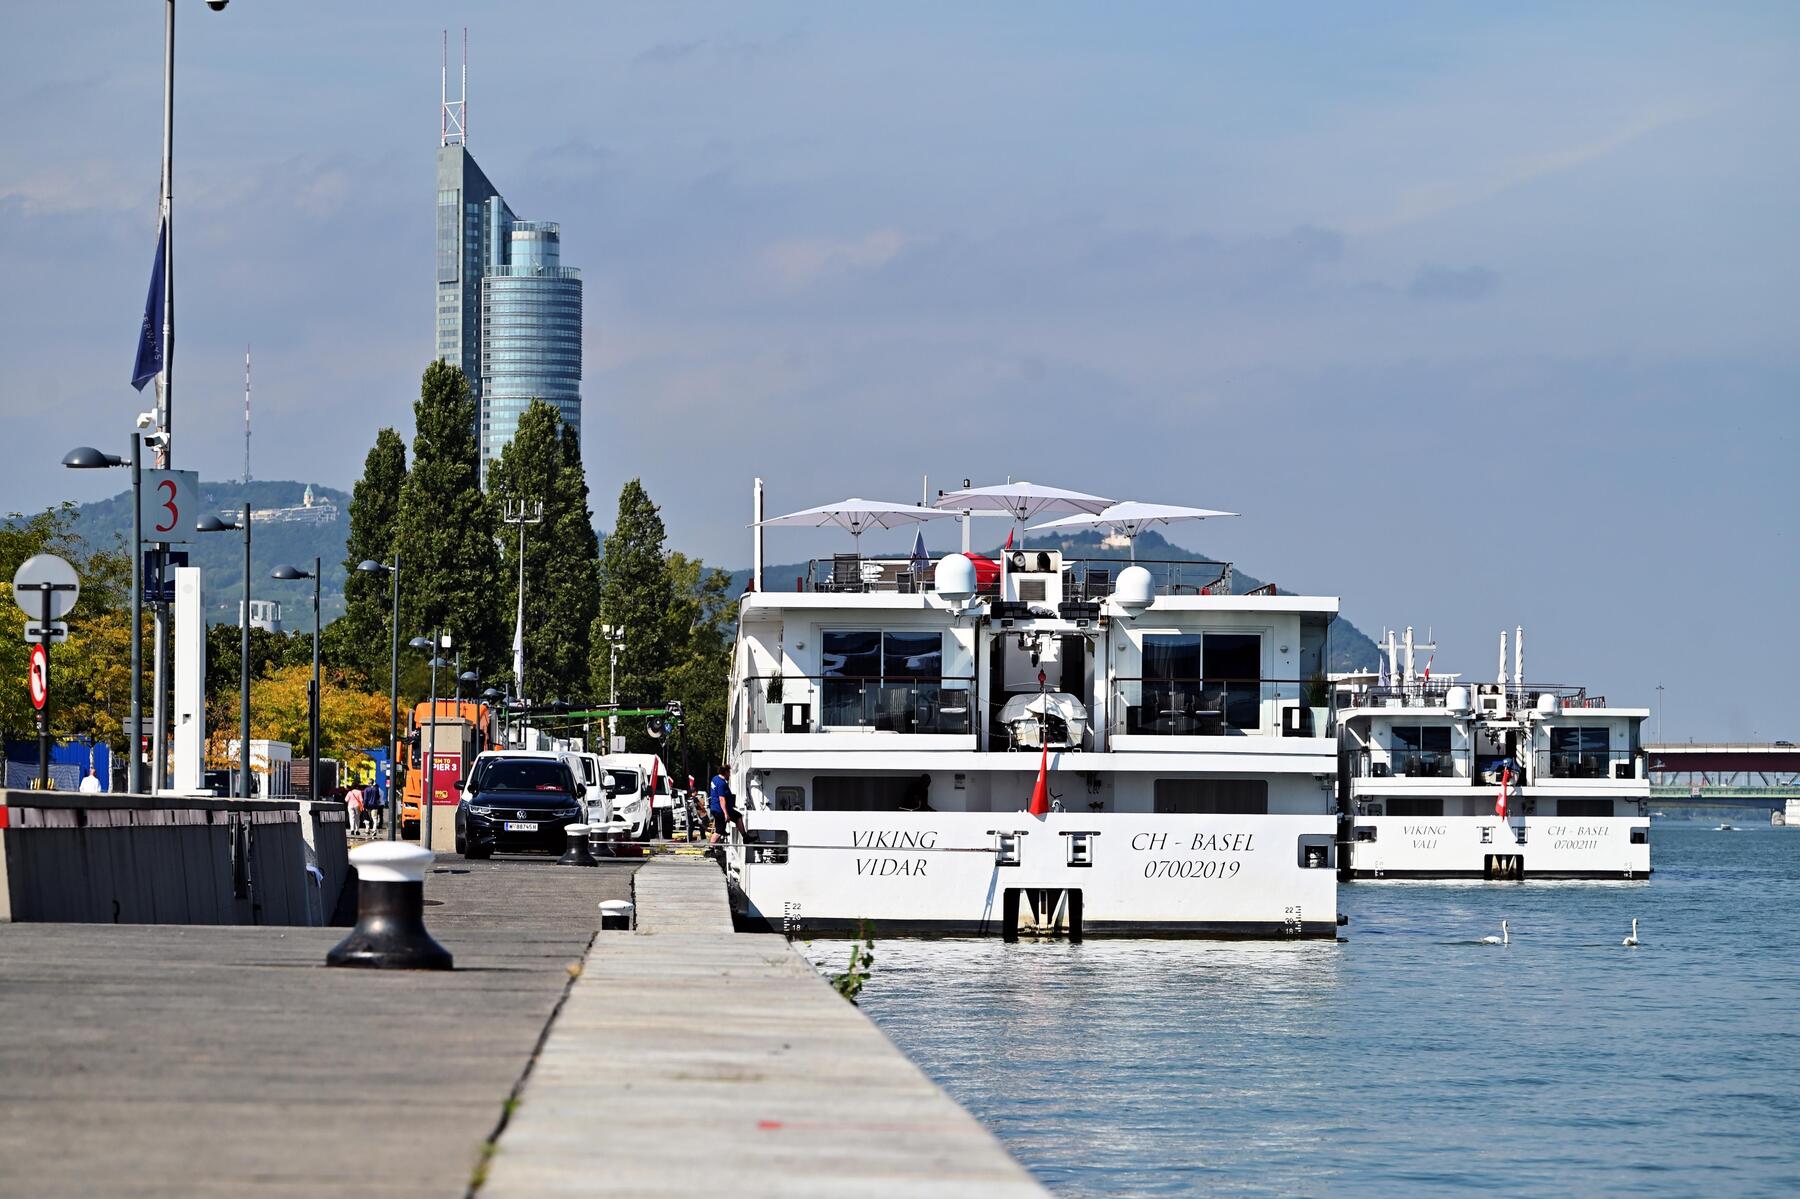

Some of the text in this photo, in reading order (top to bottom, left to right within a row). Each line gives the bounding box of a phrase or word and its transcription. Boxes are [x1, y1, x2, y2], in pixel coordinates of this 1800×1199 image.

[155, 480, 178, 532] 3
[1403, 825, 1447, 835] VIKING
[1547, 826, 1566, 836] CH
[1577, 826, 1609, 836] BASEL
[852, 830, 938, 849] VIKING
[1131, 832, 1168, 851] CH
[1190, 832, 1255, 852] BASEL
[1554, 839, 1598, 850] 07002111
[856, 858, 928, 876] VIDAR
[1144, 860, 1241, 879] 07002019
[1284, 906, 1294, 914] 22
